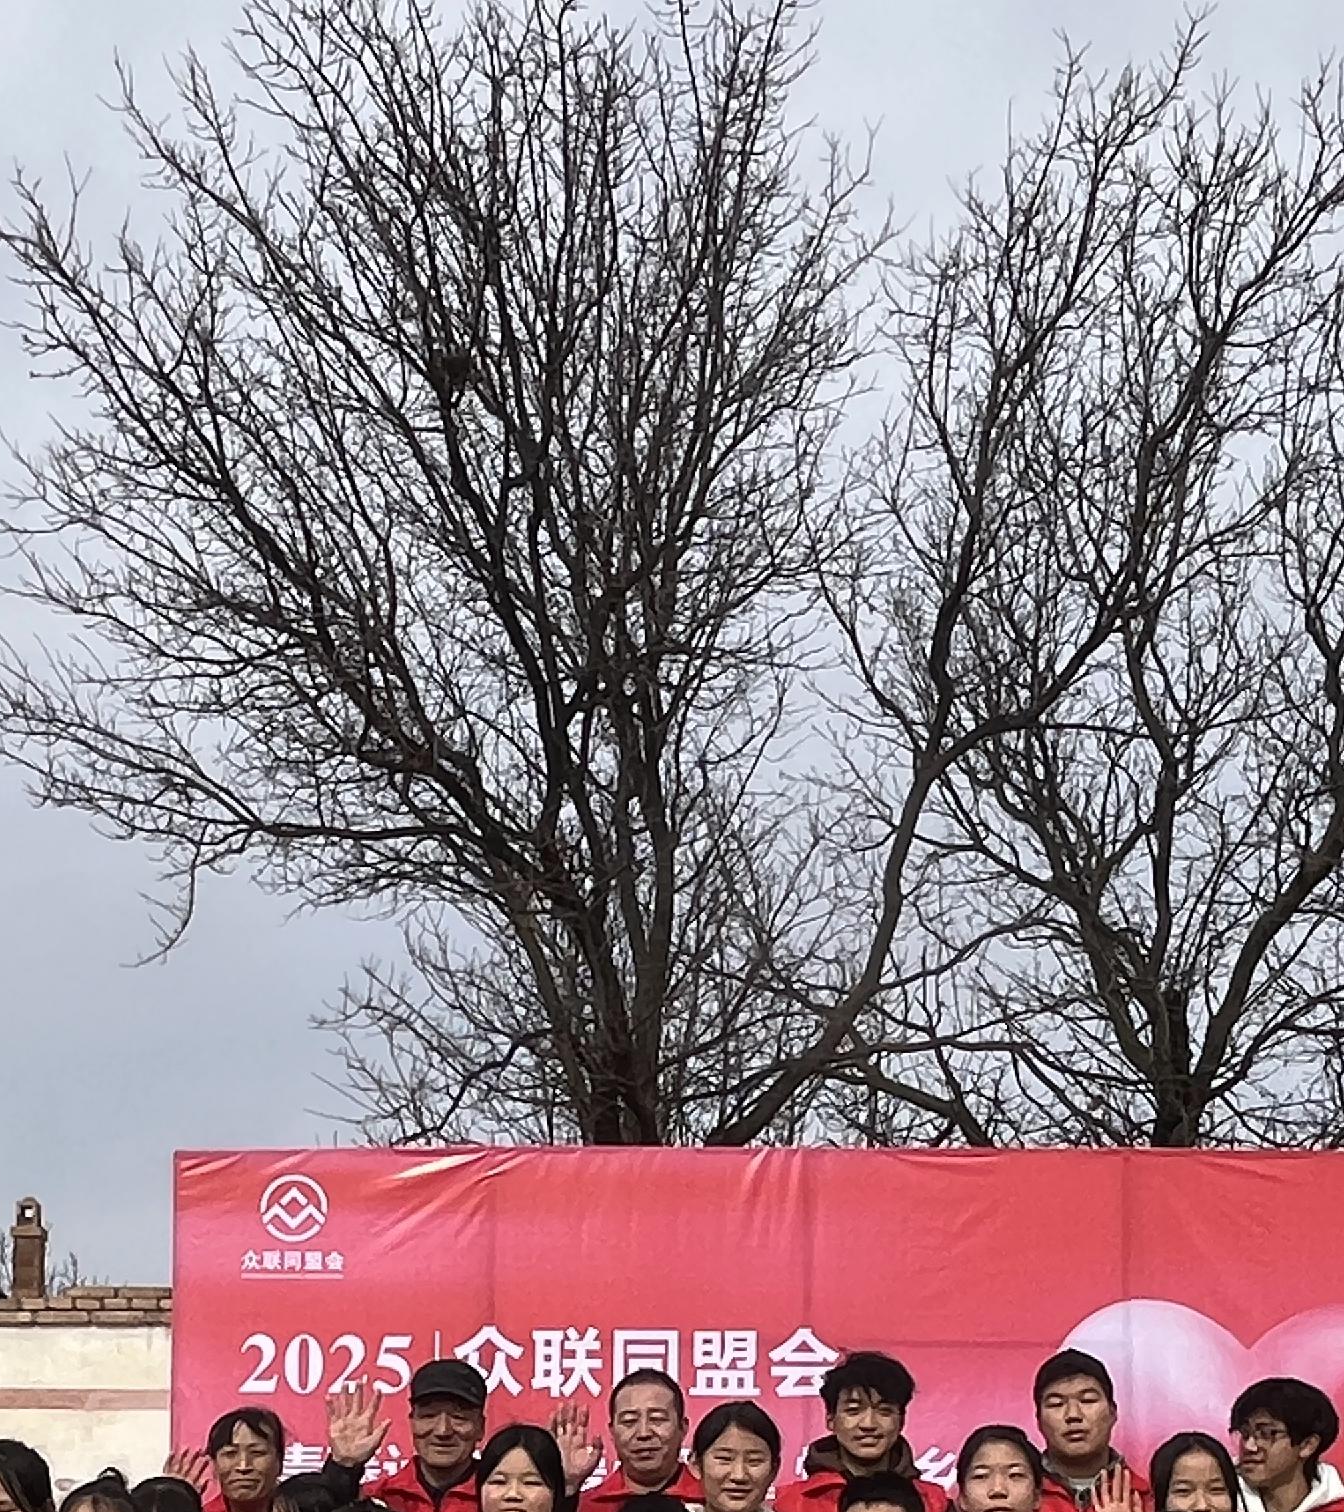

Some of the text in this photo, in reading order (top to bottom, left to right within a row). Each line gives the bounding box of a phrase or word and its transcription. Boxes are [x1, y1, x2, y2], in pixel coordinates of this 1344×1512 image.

[241, 1249, 345, 1272] 众联同盟会
[238, 1323, 840, 1399] 2025 众联同盟会
